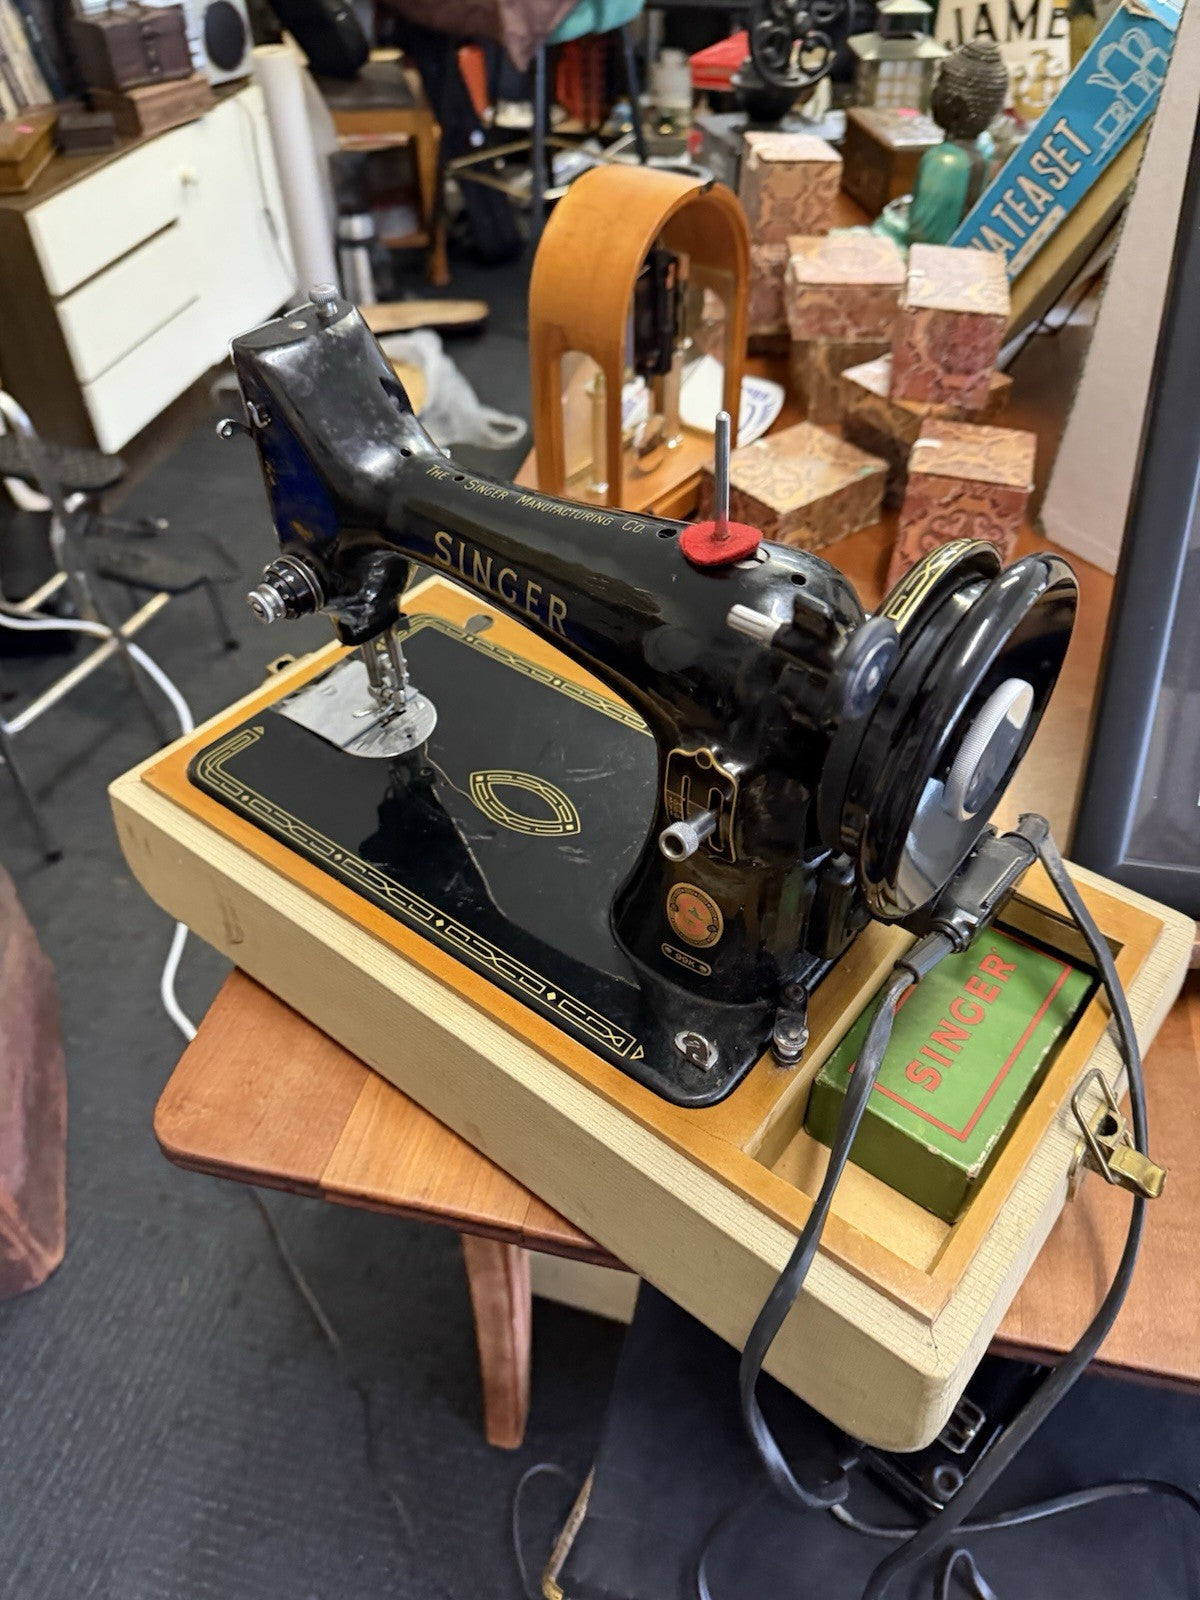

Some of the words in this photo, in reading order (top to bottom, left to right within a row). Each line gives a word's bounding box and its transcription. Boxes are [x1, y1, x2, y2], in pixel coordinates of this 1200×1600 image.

[990, 175, 1055, 238] TEA
[1029, 118, 1092, 192] SET
[426, 464, 449, 481] THE
[464, 479, 509, 501] SINGER
[515, 494, 614, 526] MANUFACTURING
[434, 531, 568, 636] SINGER
[905, 950, 1017, 1094] SINGER
